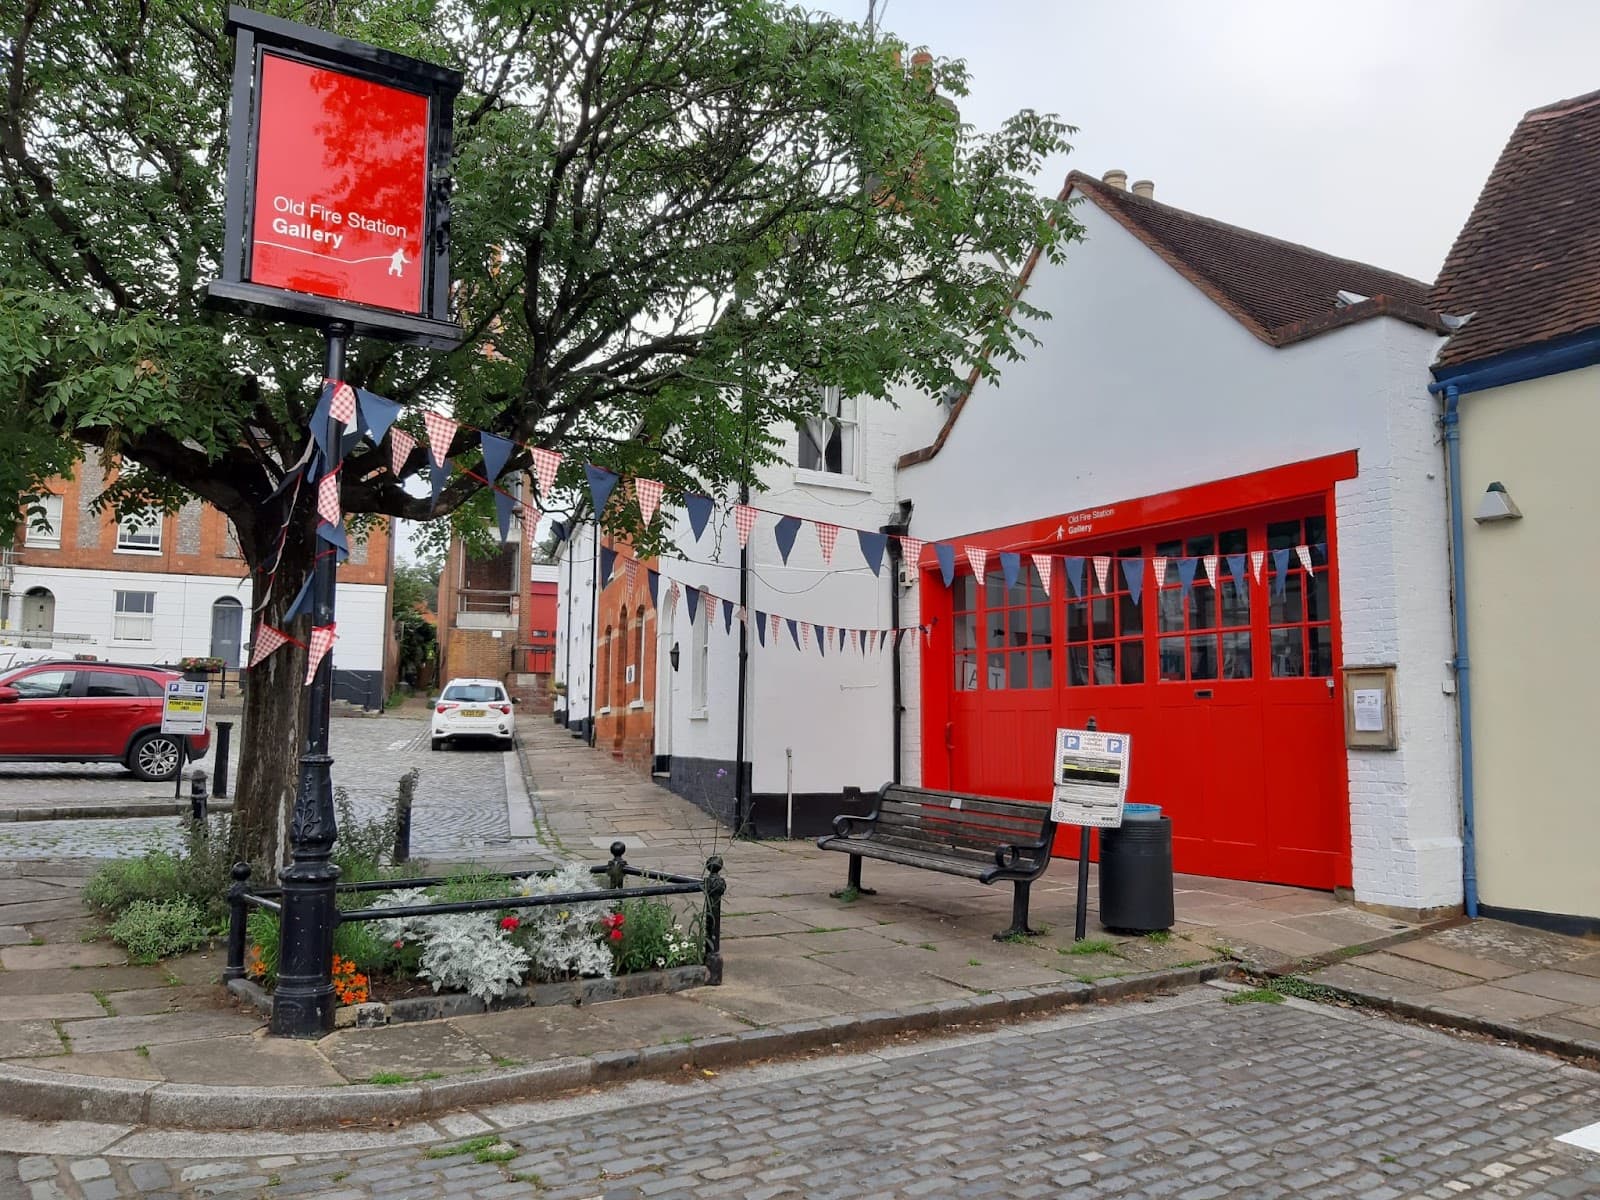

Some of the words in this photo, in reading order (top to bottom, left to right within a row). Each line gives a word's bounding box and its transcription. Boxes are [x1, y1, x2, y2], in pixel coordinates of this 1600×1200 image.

[273, 196, 305, 216] Old
[309, 204, 342, 224] Fire
[347, 212, 407, 239] Station
[272, 218, 343, 249] Gallery
[1068, 515, 1079, 524] Old
[1080, 513, 1092, 522] Fire
[1092, 508, 1114, 519] Station
[1068, 524, 1092, 535] Gallery
[1067, 737, 1077, 748] P
[1110, 741, 1120, 751] P
